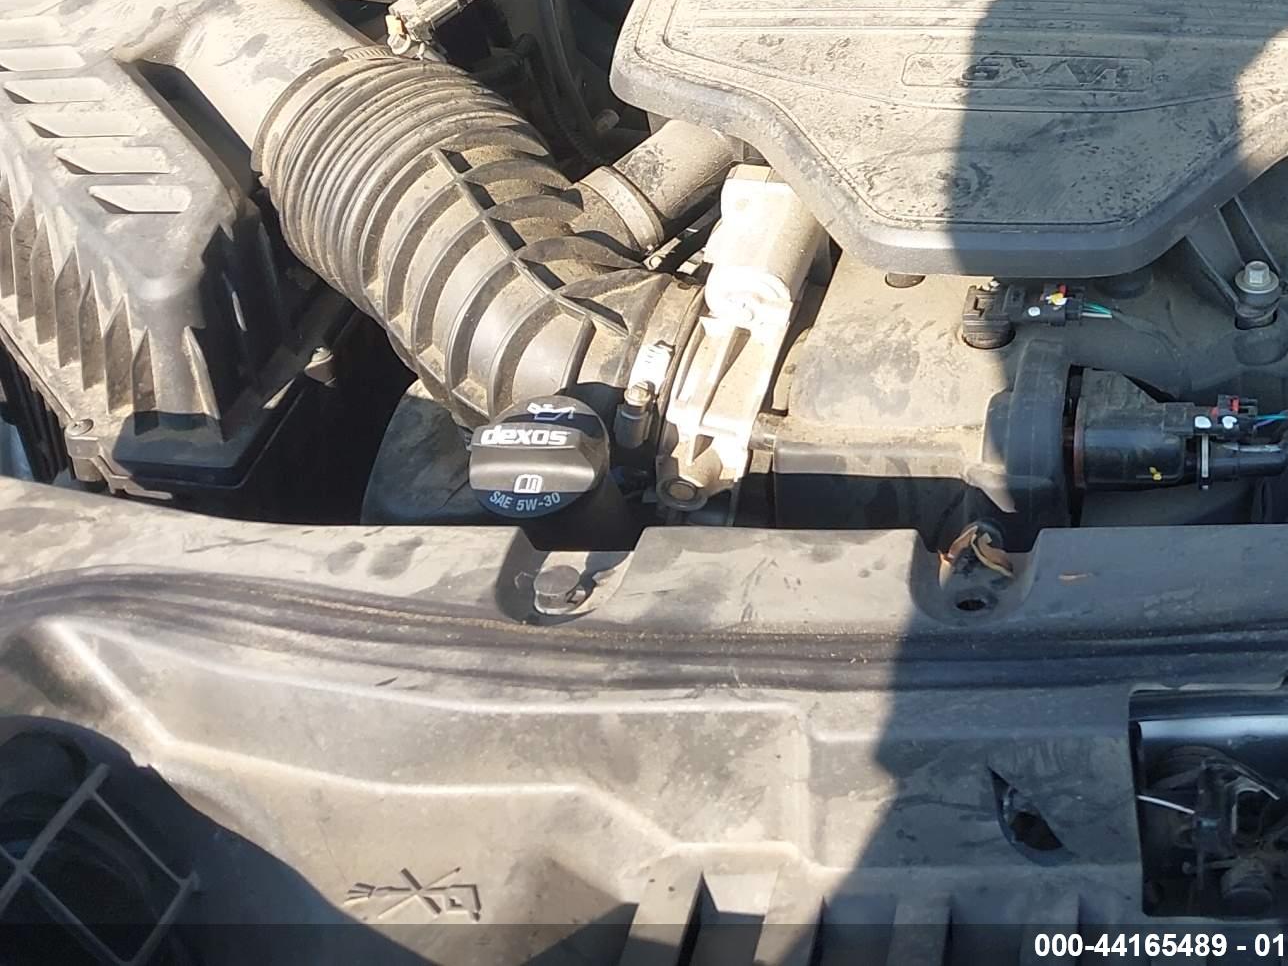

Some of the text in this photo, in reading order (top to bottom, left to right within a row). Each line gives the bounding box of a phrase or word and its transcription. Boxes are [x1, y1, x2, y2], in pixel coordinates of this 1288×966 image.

[480, 425, 568, 445] dexos
[489, 491, 561, 511] SAE 5W-30
